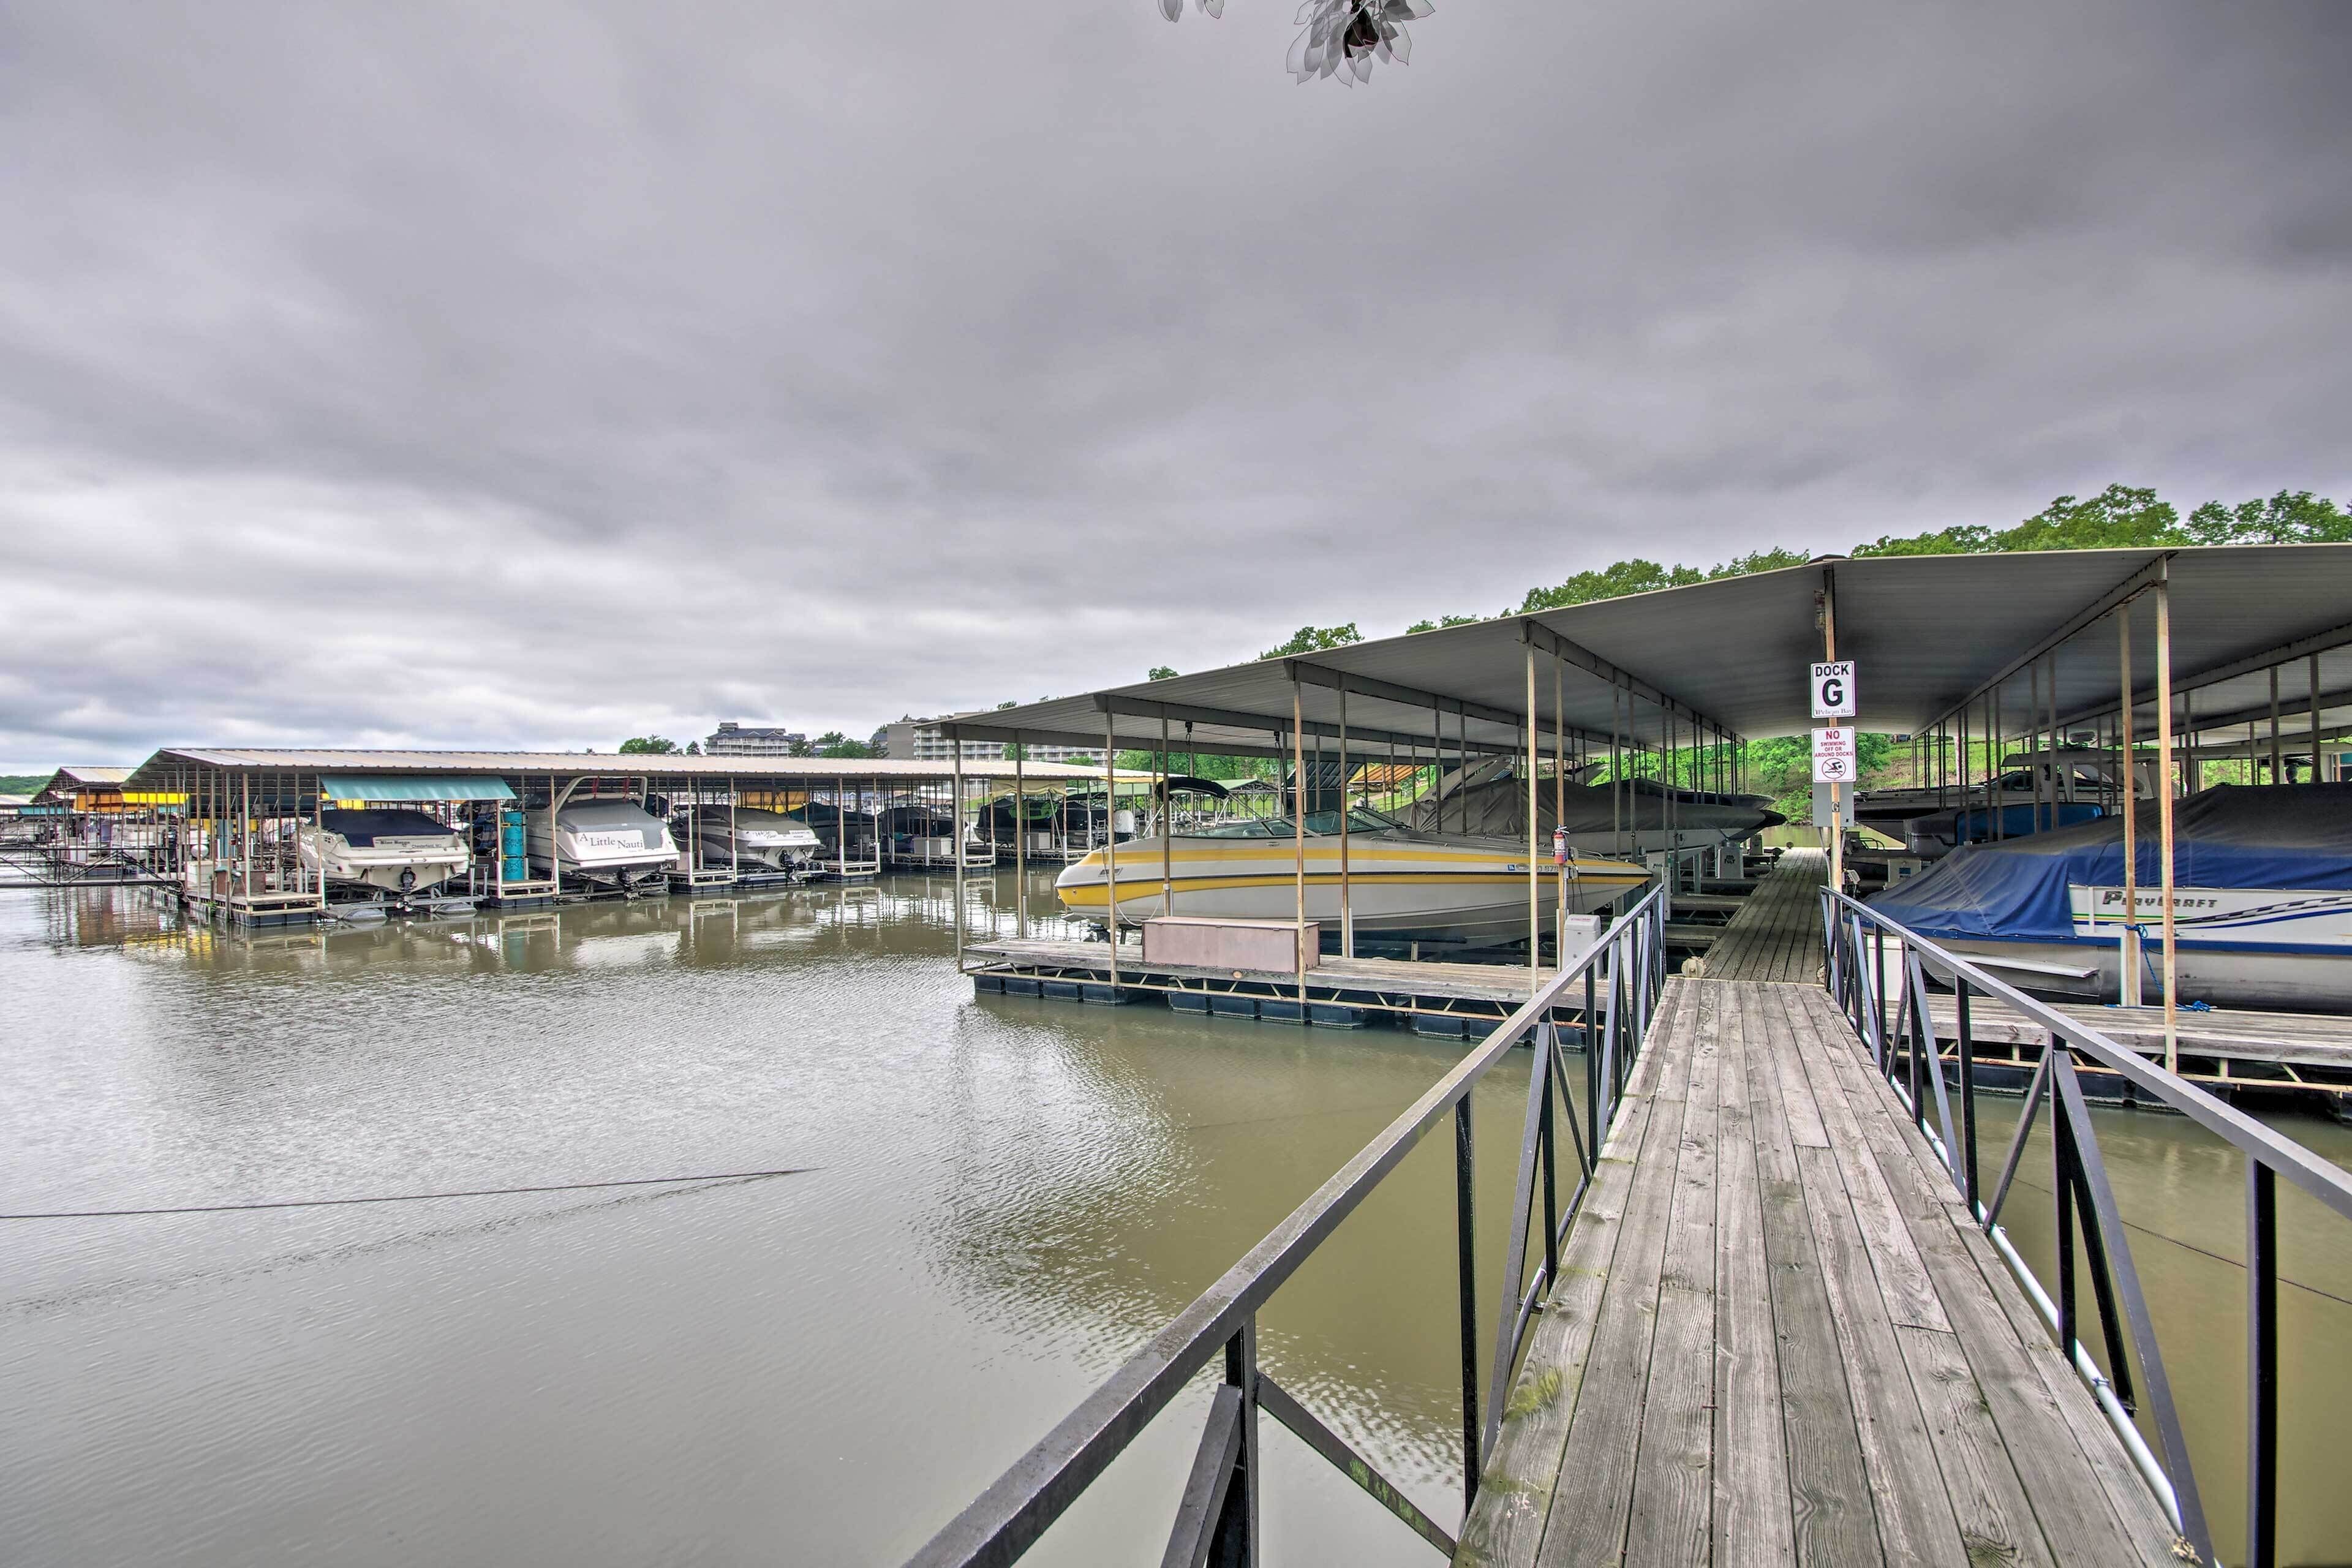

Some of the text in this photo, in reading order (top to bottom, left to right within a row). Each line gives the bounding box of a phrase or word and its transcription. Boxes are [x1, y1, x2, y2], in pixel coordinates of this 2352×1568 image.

[1815, 665, 1849, 677] DOCK
[1822, 679, 1843, 707] G
[1826, 730, 1840, 740] NO
[1831, 802, 1840, 812] G
[590, 837, 616, 846] Little
[617, 840, 643, 849] Nauti
